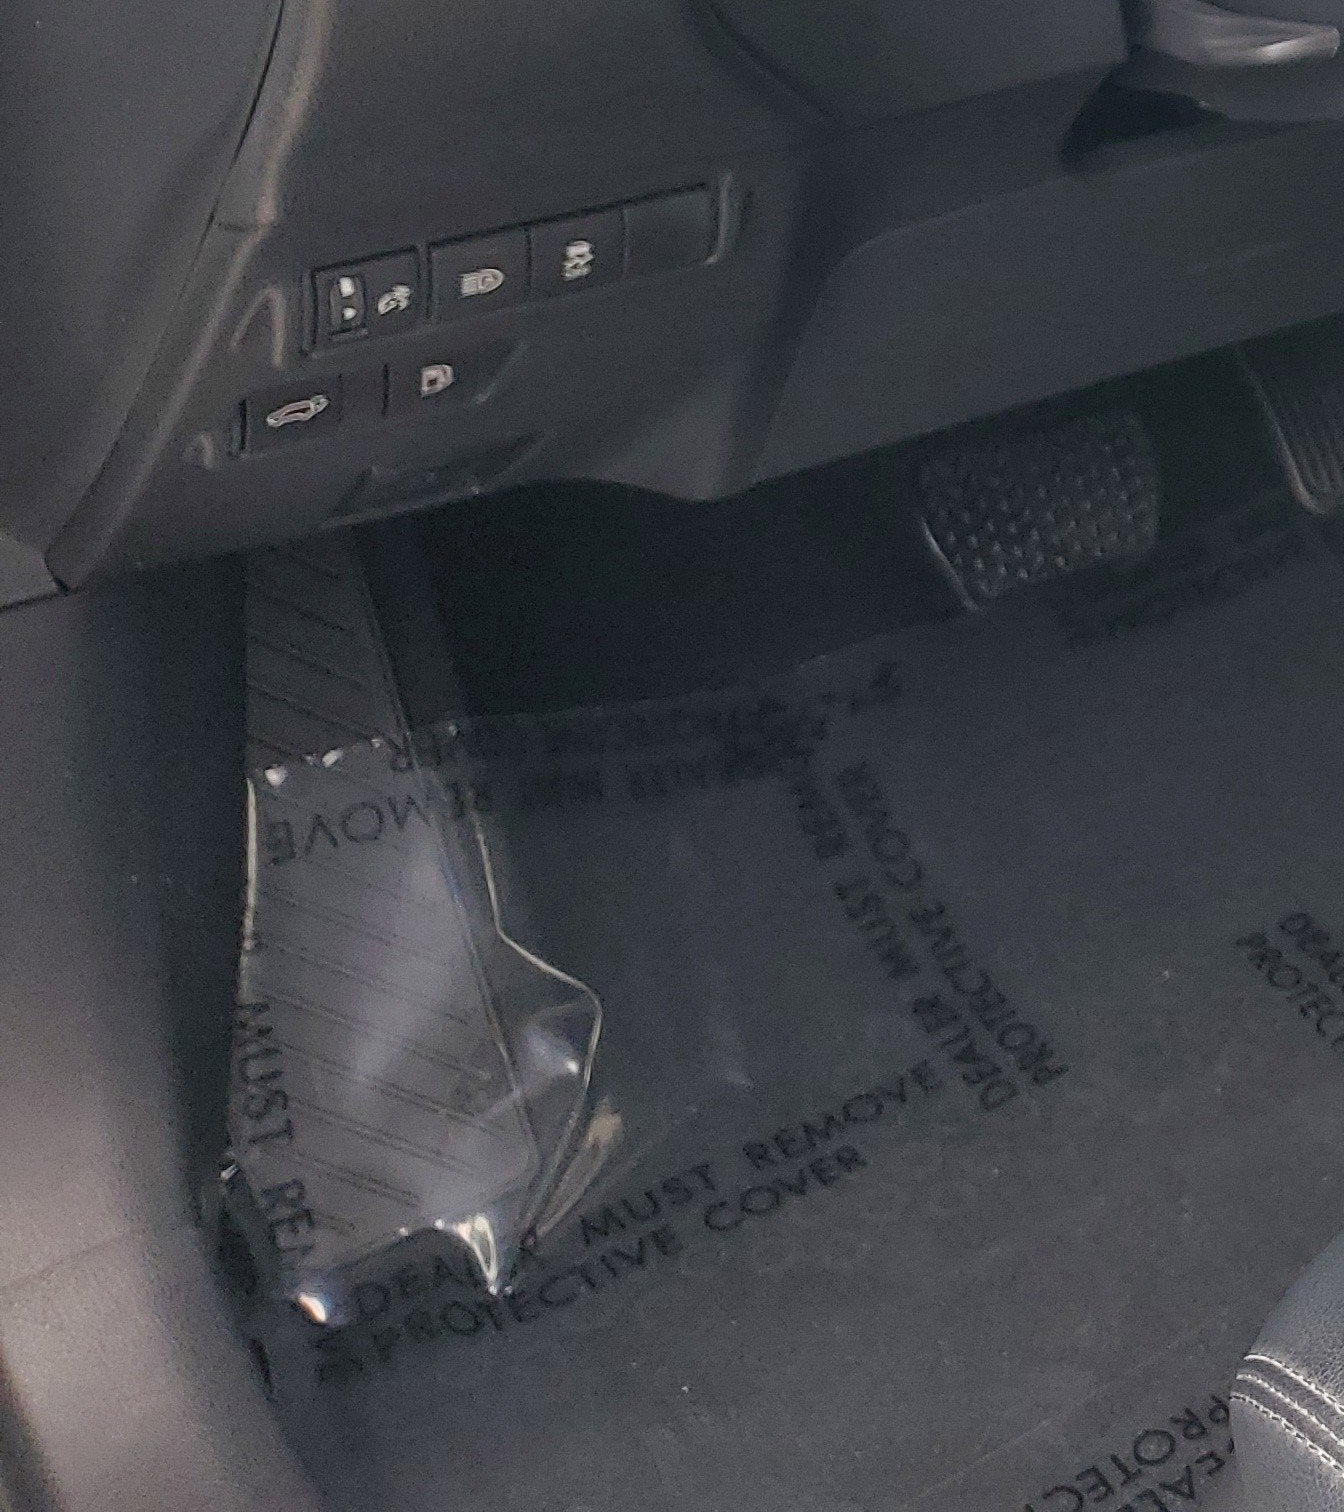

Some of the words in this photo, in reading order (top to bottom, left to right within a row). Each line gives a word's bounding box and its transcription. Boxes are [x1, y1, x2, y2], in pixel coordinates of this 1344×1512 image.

[909, 899, 1071, 1090] PROTECTIVE
[579, 1159, 717, 1248] MUST
[740, 1059, 938, 1168] REMOVE
[376, 1228, 687, 1362] PROTECTIVE
[702, 1145, 868, 1235] COVER
